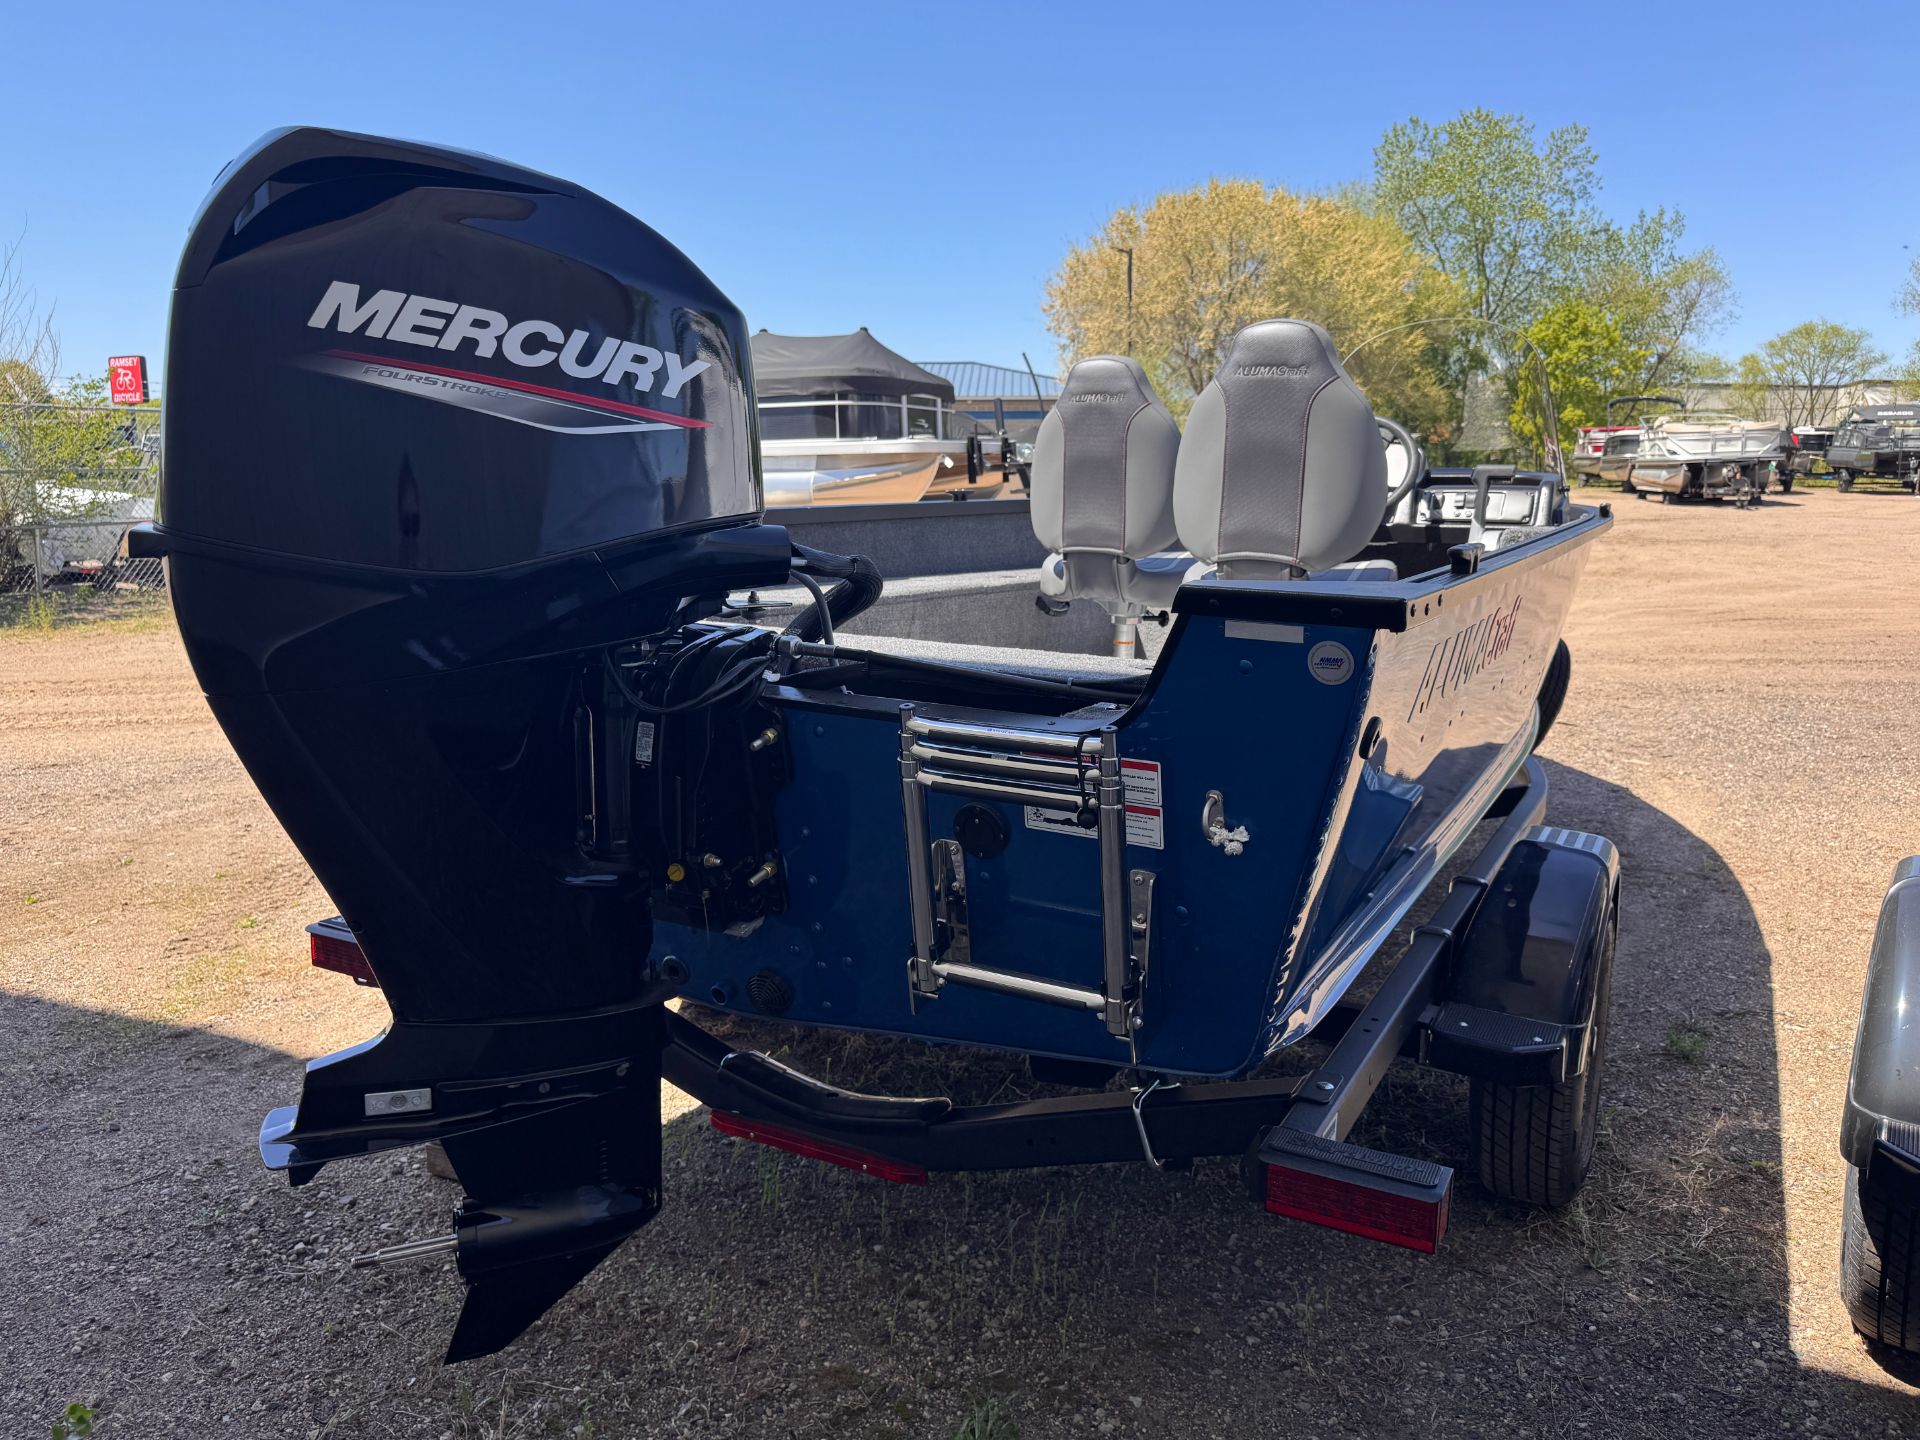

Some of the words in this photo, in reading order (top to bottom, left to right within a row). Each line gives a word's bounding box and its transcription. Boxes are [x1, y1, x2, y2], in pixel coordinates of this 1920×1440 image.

[307, 280, 711, 399] MERCURY
[110, 357, 137, 366] RAMSEY
[114, 392, 141, 402] BICYCLE
